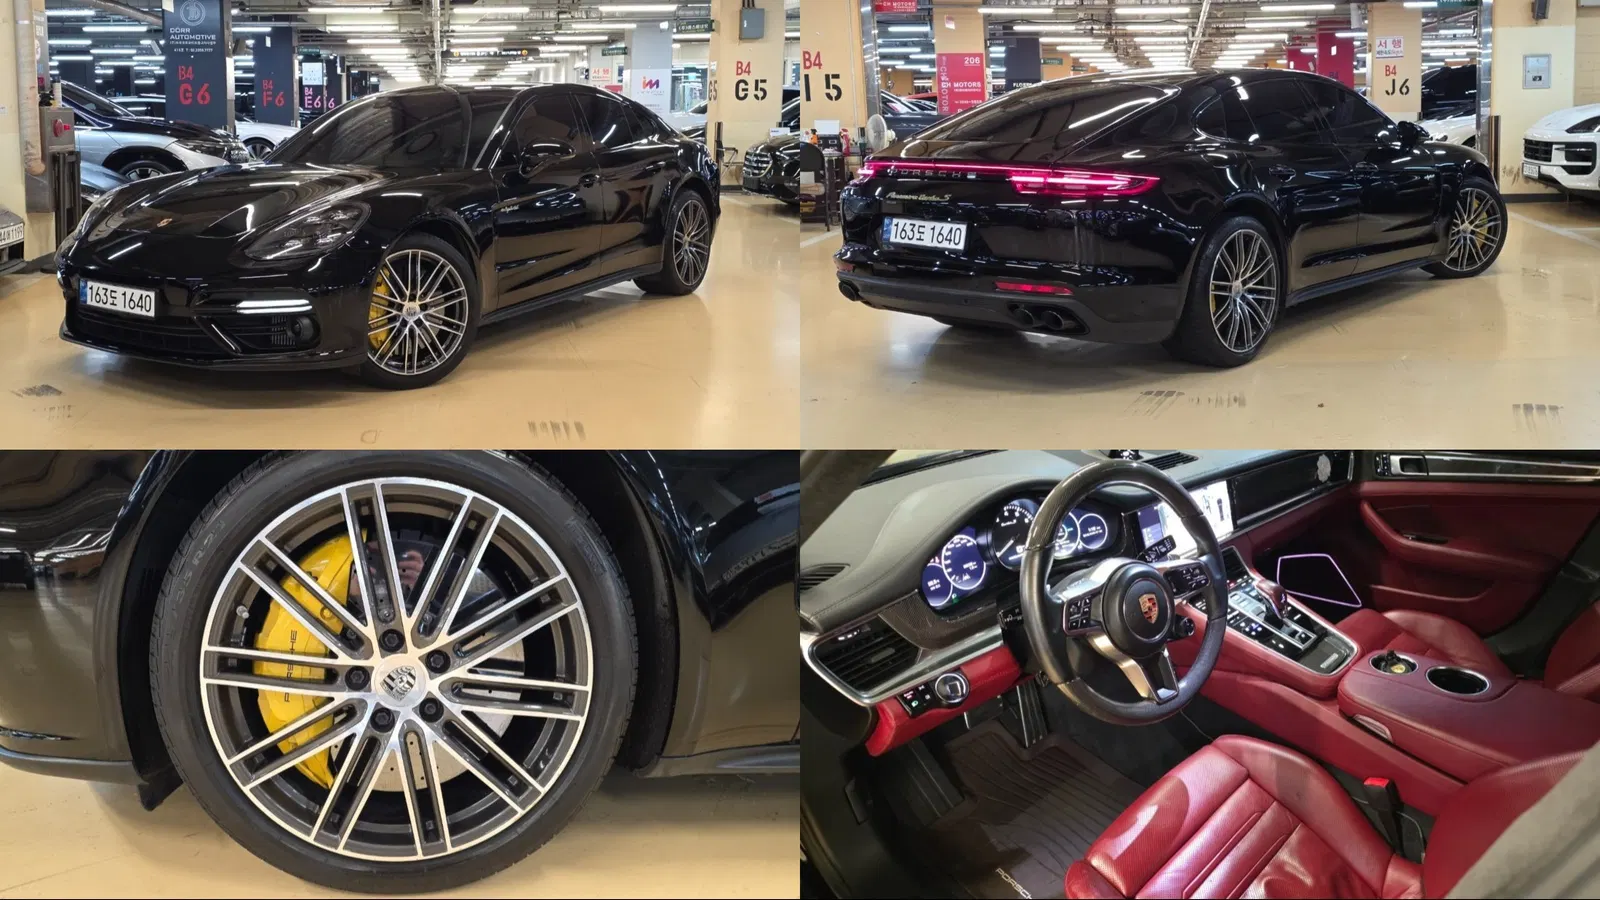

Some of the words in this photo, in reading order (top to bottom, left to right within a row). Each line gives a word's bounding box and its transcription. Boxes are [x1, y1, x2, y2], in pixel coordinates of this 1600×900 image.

[803, 51, 823, 70] B4
[964, 57, 980, 65] 206
[178, 66, 194, 81] B4
[736, 61, 751, 76] B4
[1385, 65, 1397, 77] B4
[262, 79, 273, 90] B4
[304, 87, 313, 95] B4
[304, 96, 322, 108] E6
[894, 221, 926, 241] 163도
[930, 225, 962, 246] 1640
[88, 285, 118, 307] 163도
[121, 290, 152, 313] 1640
[284, 630, 298, 703] PRSHE
